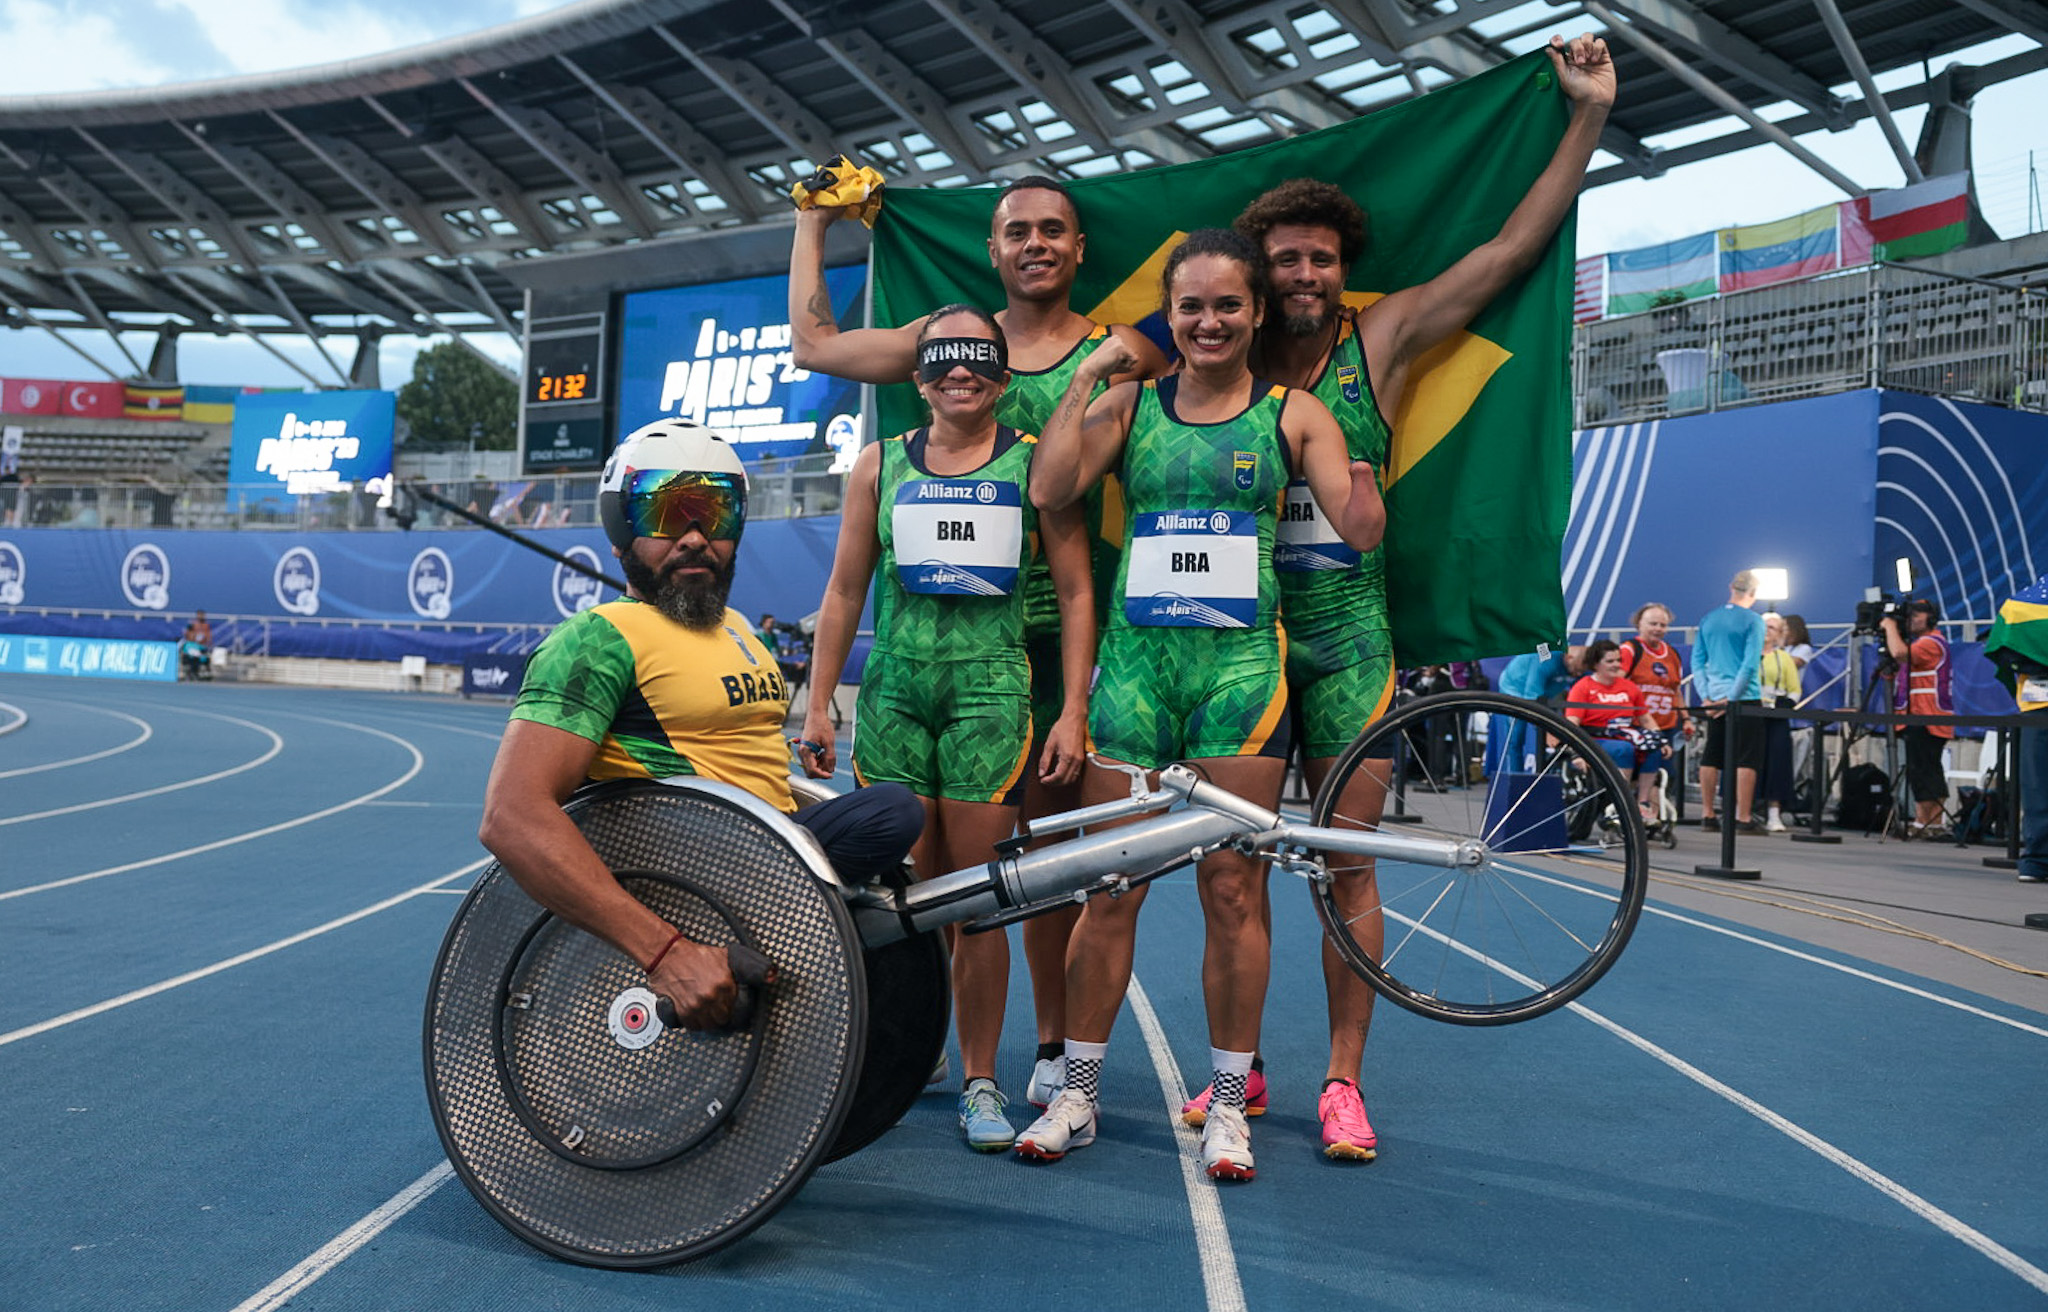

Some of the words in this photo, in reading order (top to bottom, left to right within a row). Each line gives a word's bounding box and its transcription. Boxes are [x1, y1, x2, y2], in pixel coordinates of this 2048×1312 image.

[924, 342, 999, 364] WINNER
[918, 484, 973, 498] Allianz
[937, 521, 976, 541] BRA
[1155, 514, 1208, 530] Allianz
[1171, 552, 1210, 573] BRA
